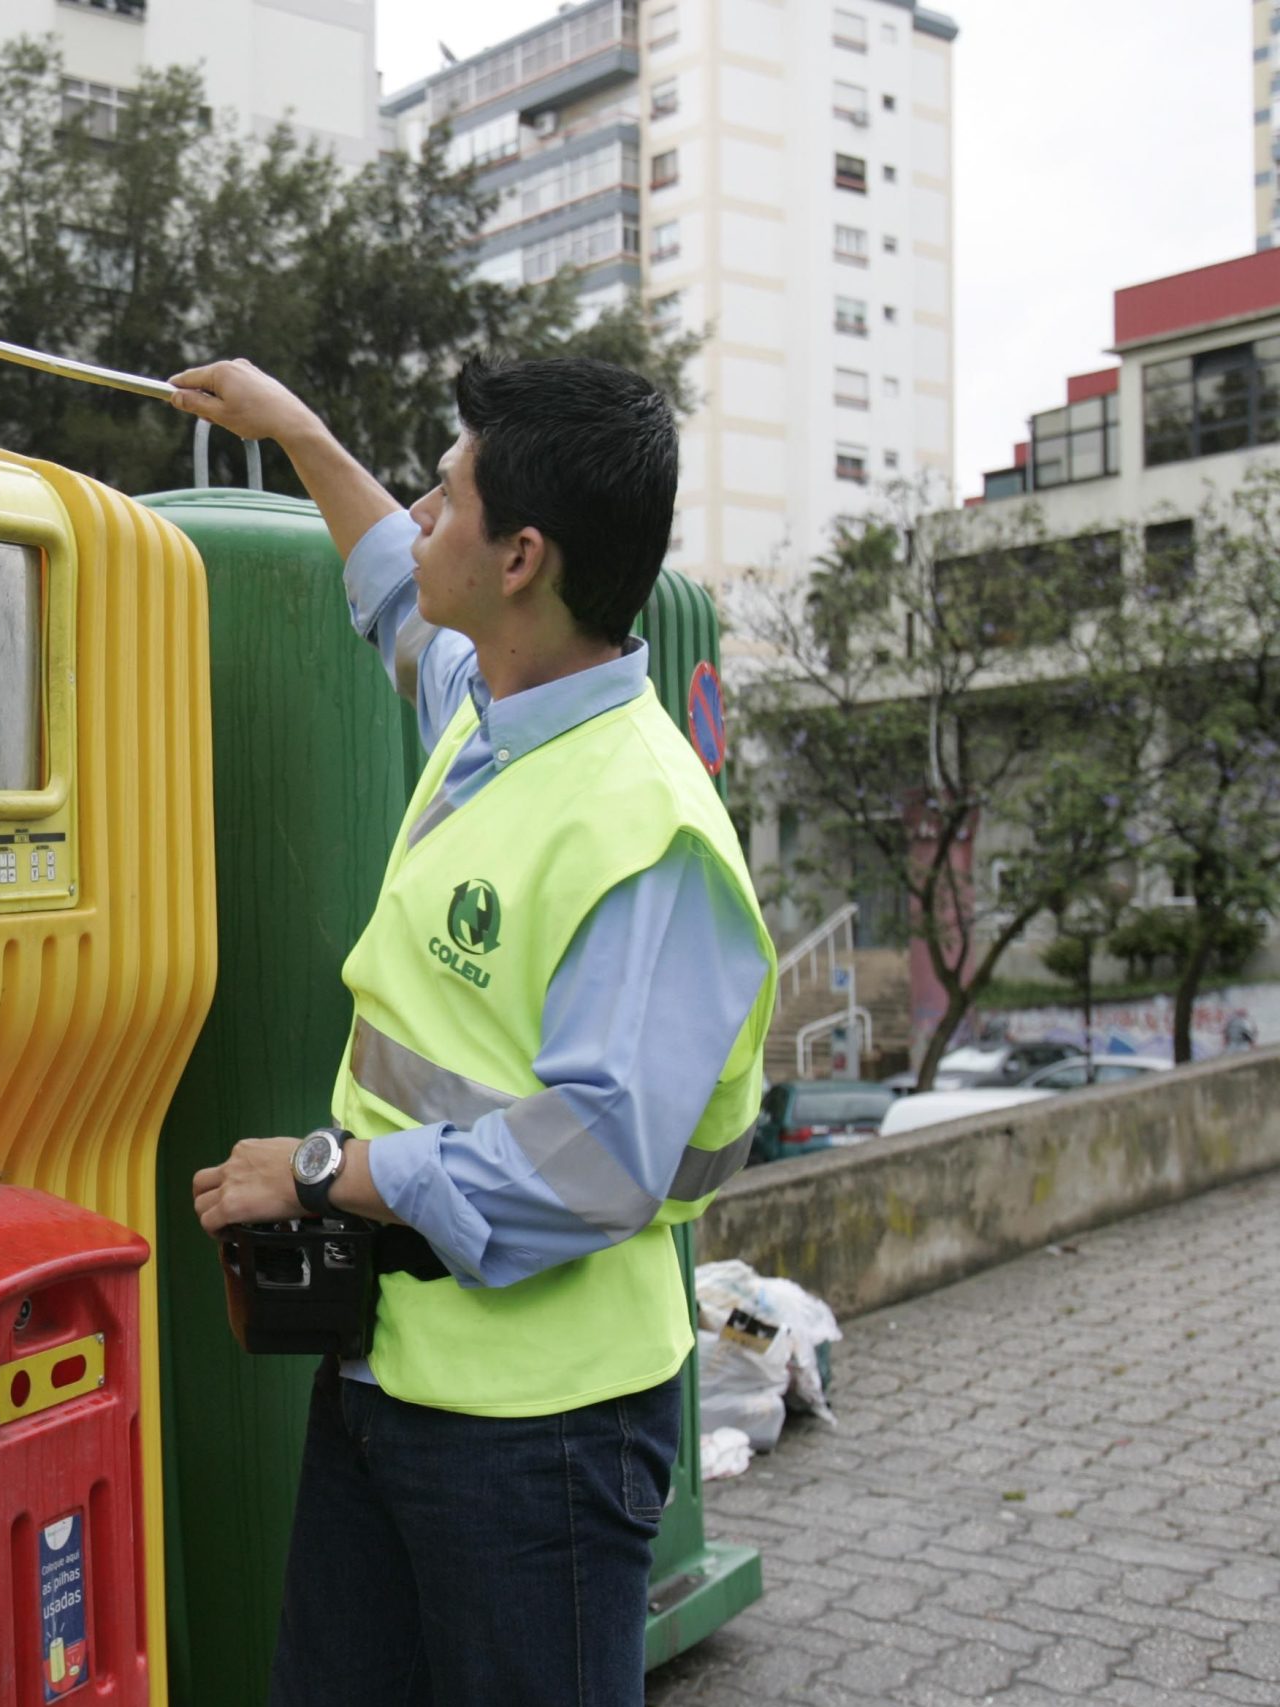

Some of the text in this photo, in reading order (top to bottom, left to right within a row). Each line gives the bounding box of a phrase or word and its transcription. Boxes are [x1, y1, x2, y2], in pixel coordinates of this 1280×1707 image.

[428, 936, 491, 988] COLEU
[42, 1568, 80, 1596] as pilhas
[43, 1589, 81, 1620] usadas
